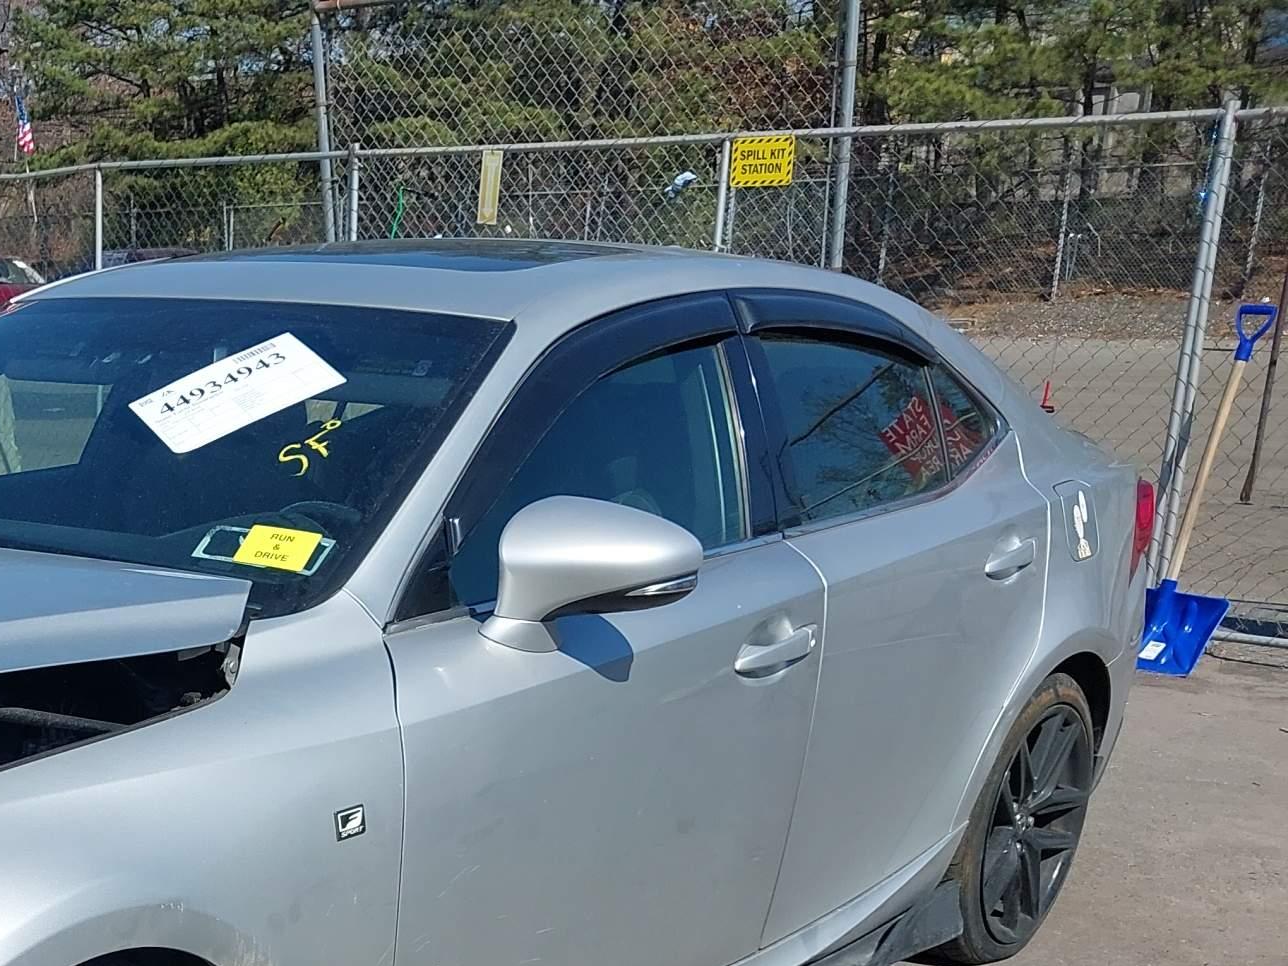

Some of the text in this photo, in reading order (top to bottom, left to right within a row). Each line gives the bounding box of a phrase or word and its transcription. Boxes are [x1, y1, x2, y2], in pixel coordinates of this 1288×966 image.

[740, 148, 786, 160] SPILL KIT
[741, 163, 782, 175] STATION
[160, 352, 286, 415] 44934943
[270, 533, 296, 543] RUN
[254, 550, 289, 562] DRIVE
[340, 825, 365, 838] SPORT
